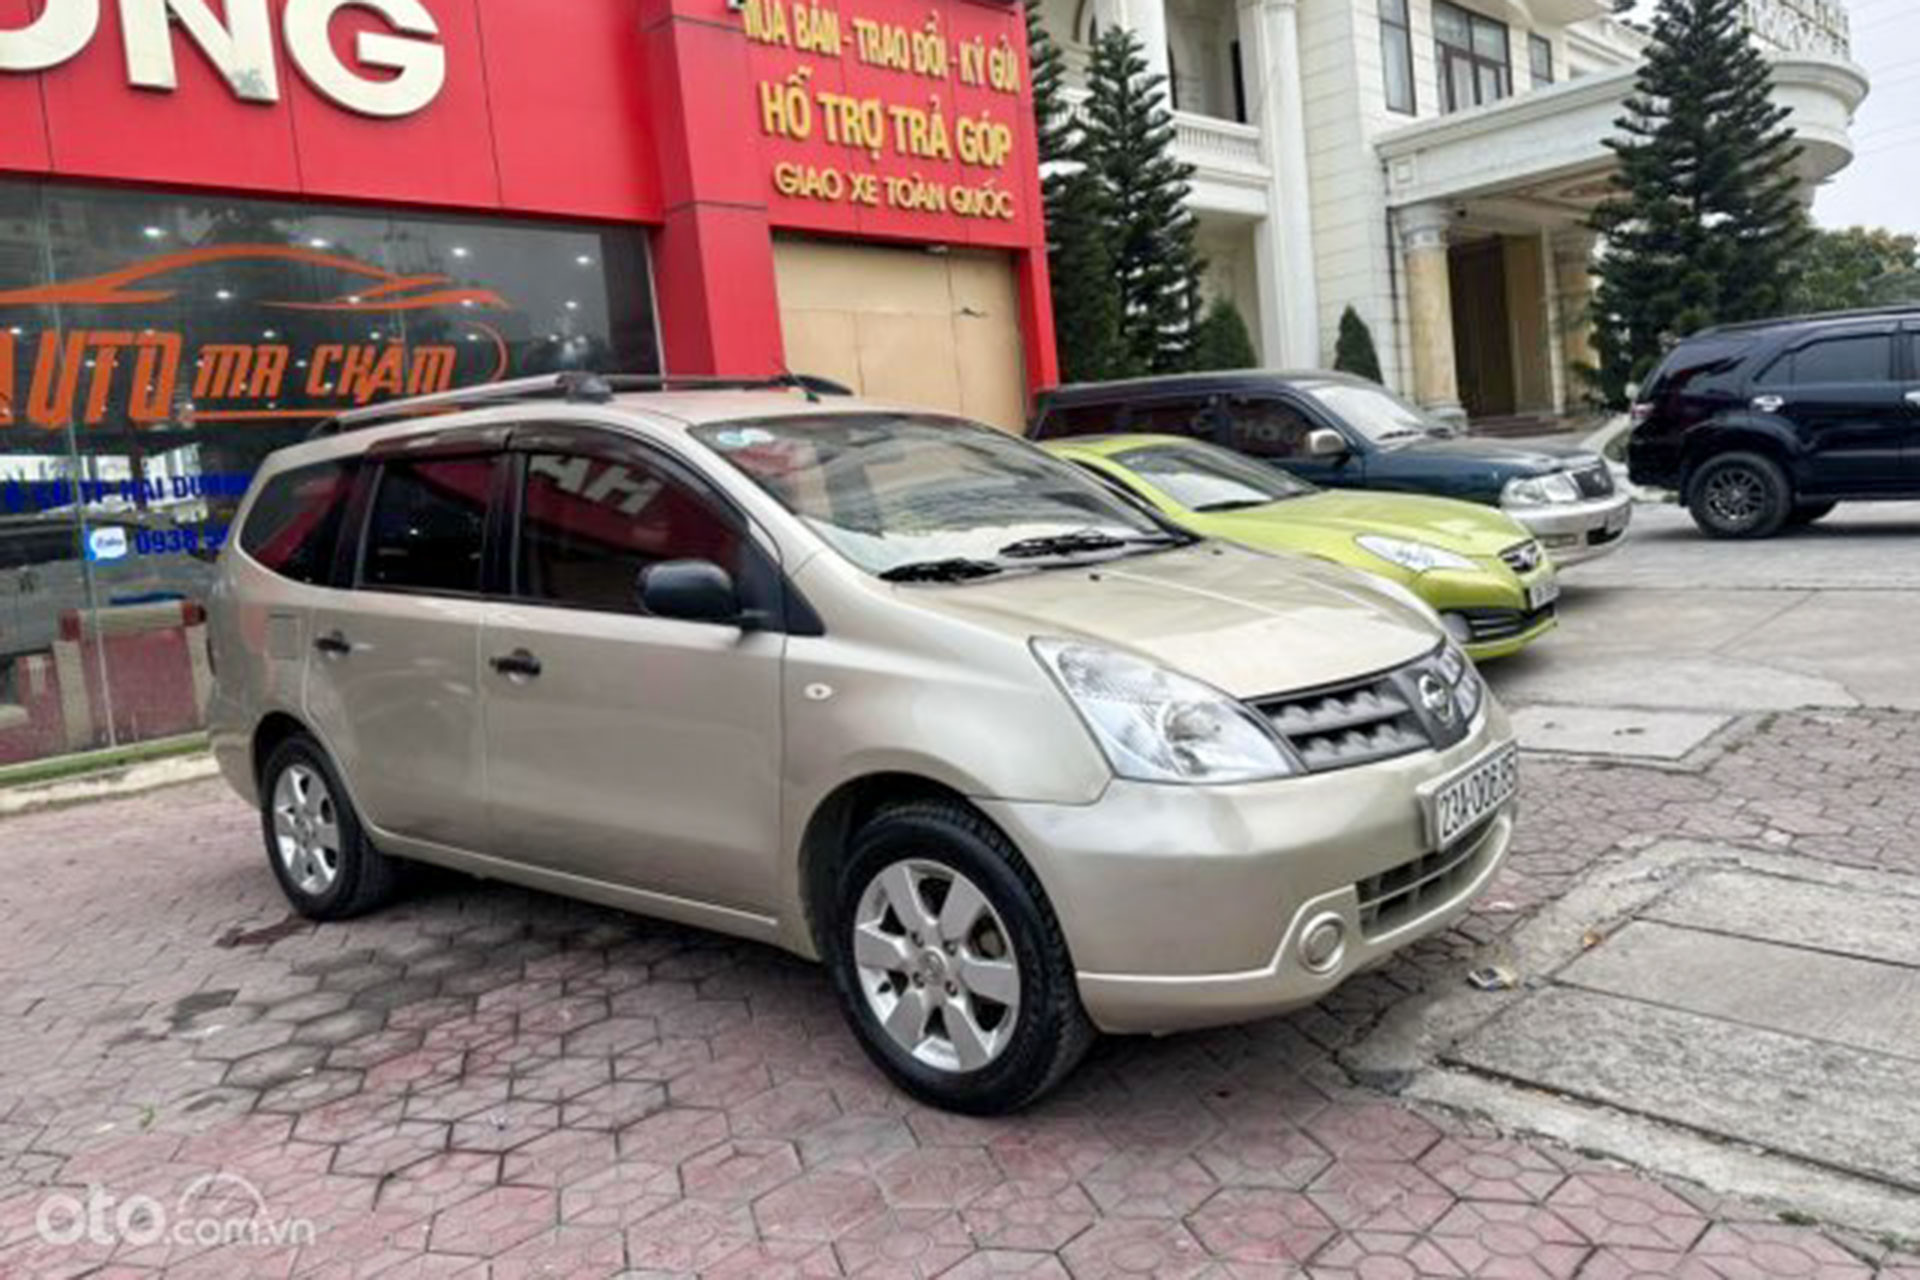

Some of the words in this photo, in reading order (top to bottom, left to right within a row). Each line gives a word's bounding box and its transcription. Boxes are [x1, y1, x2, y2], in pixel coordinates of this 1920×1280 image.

[853, 17, 909, 70] TRAO
[959, 35, 985, 85] KÝ
[760, 66, 811, 139] HỖ
[889, 94, 950, 159] TRẢ
[956, 110, 1011, 166] GÓP
[775, 162, 843, 200] GIAO
[848, 173, 878, 204] XE
[884, 172, 946, 211] TOÀN
[951, 179, 1014, 218] QUỐC
